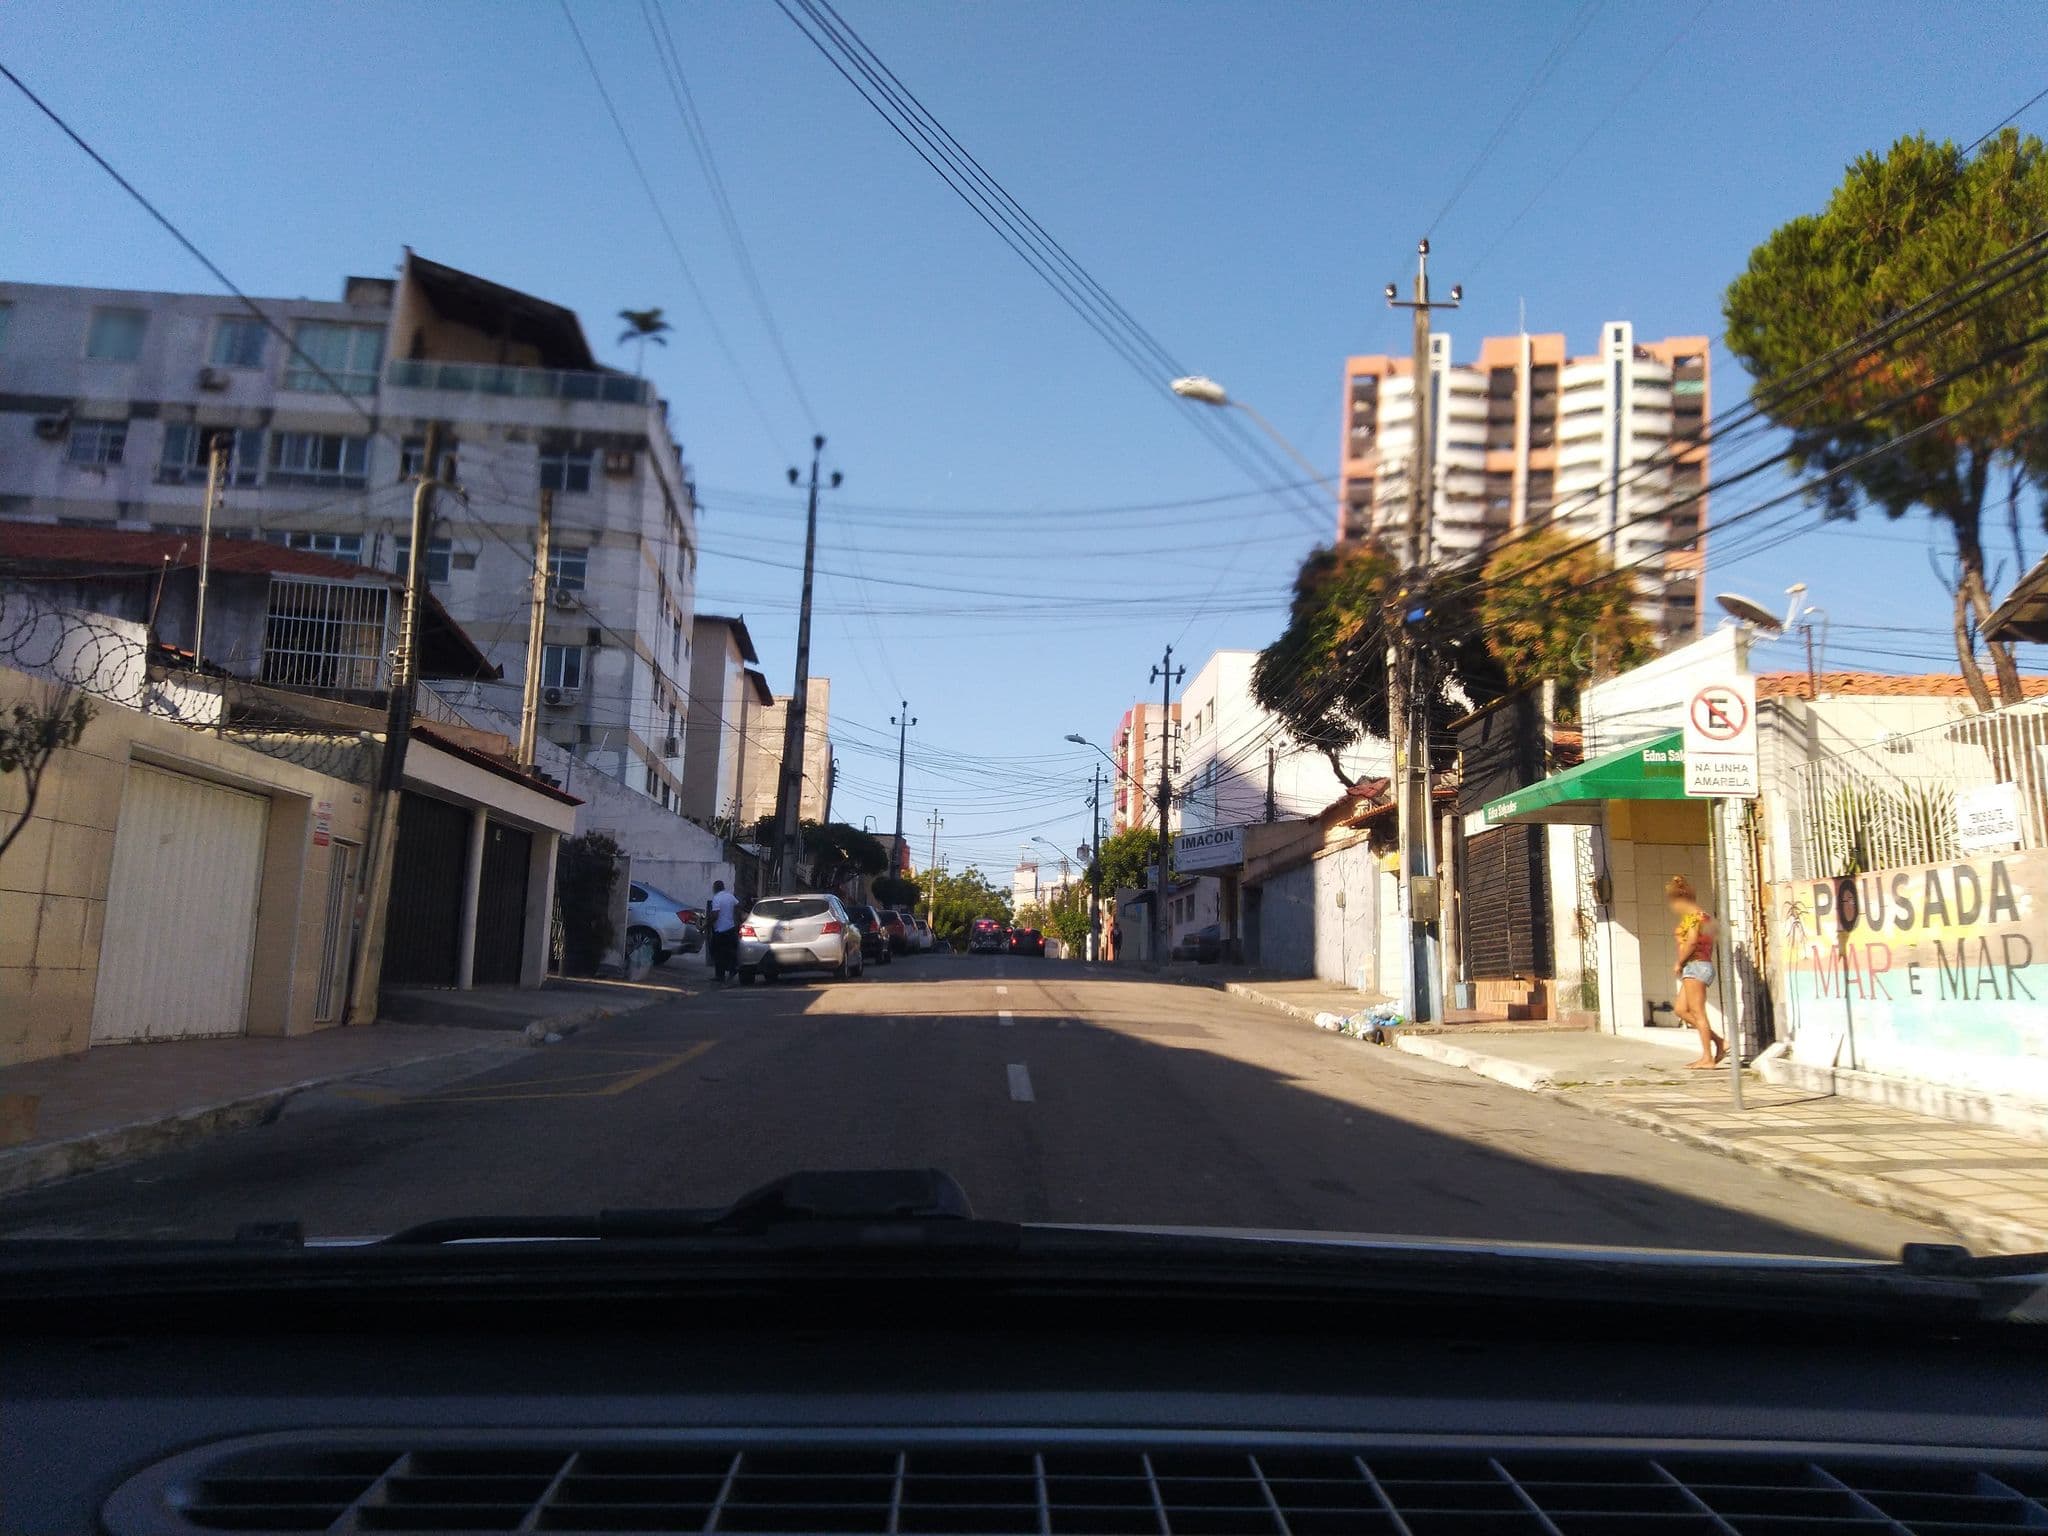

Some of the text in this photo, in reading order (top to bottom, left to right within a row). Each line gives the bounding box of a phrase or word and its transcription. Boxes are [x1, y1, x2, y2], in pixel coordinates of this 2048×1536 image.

[1643, 750, 1667, 761] Edna
[1695, 763, 1748, 773] NA LINHA
[1694, 777, 1750, 786] AMARELA
[1181, 830, 1234, 850] IMACON
[1813, 860, 2020, 935] POUSADA
[1812, 933, 2036, 1000] MAR E MAR
